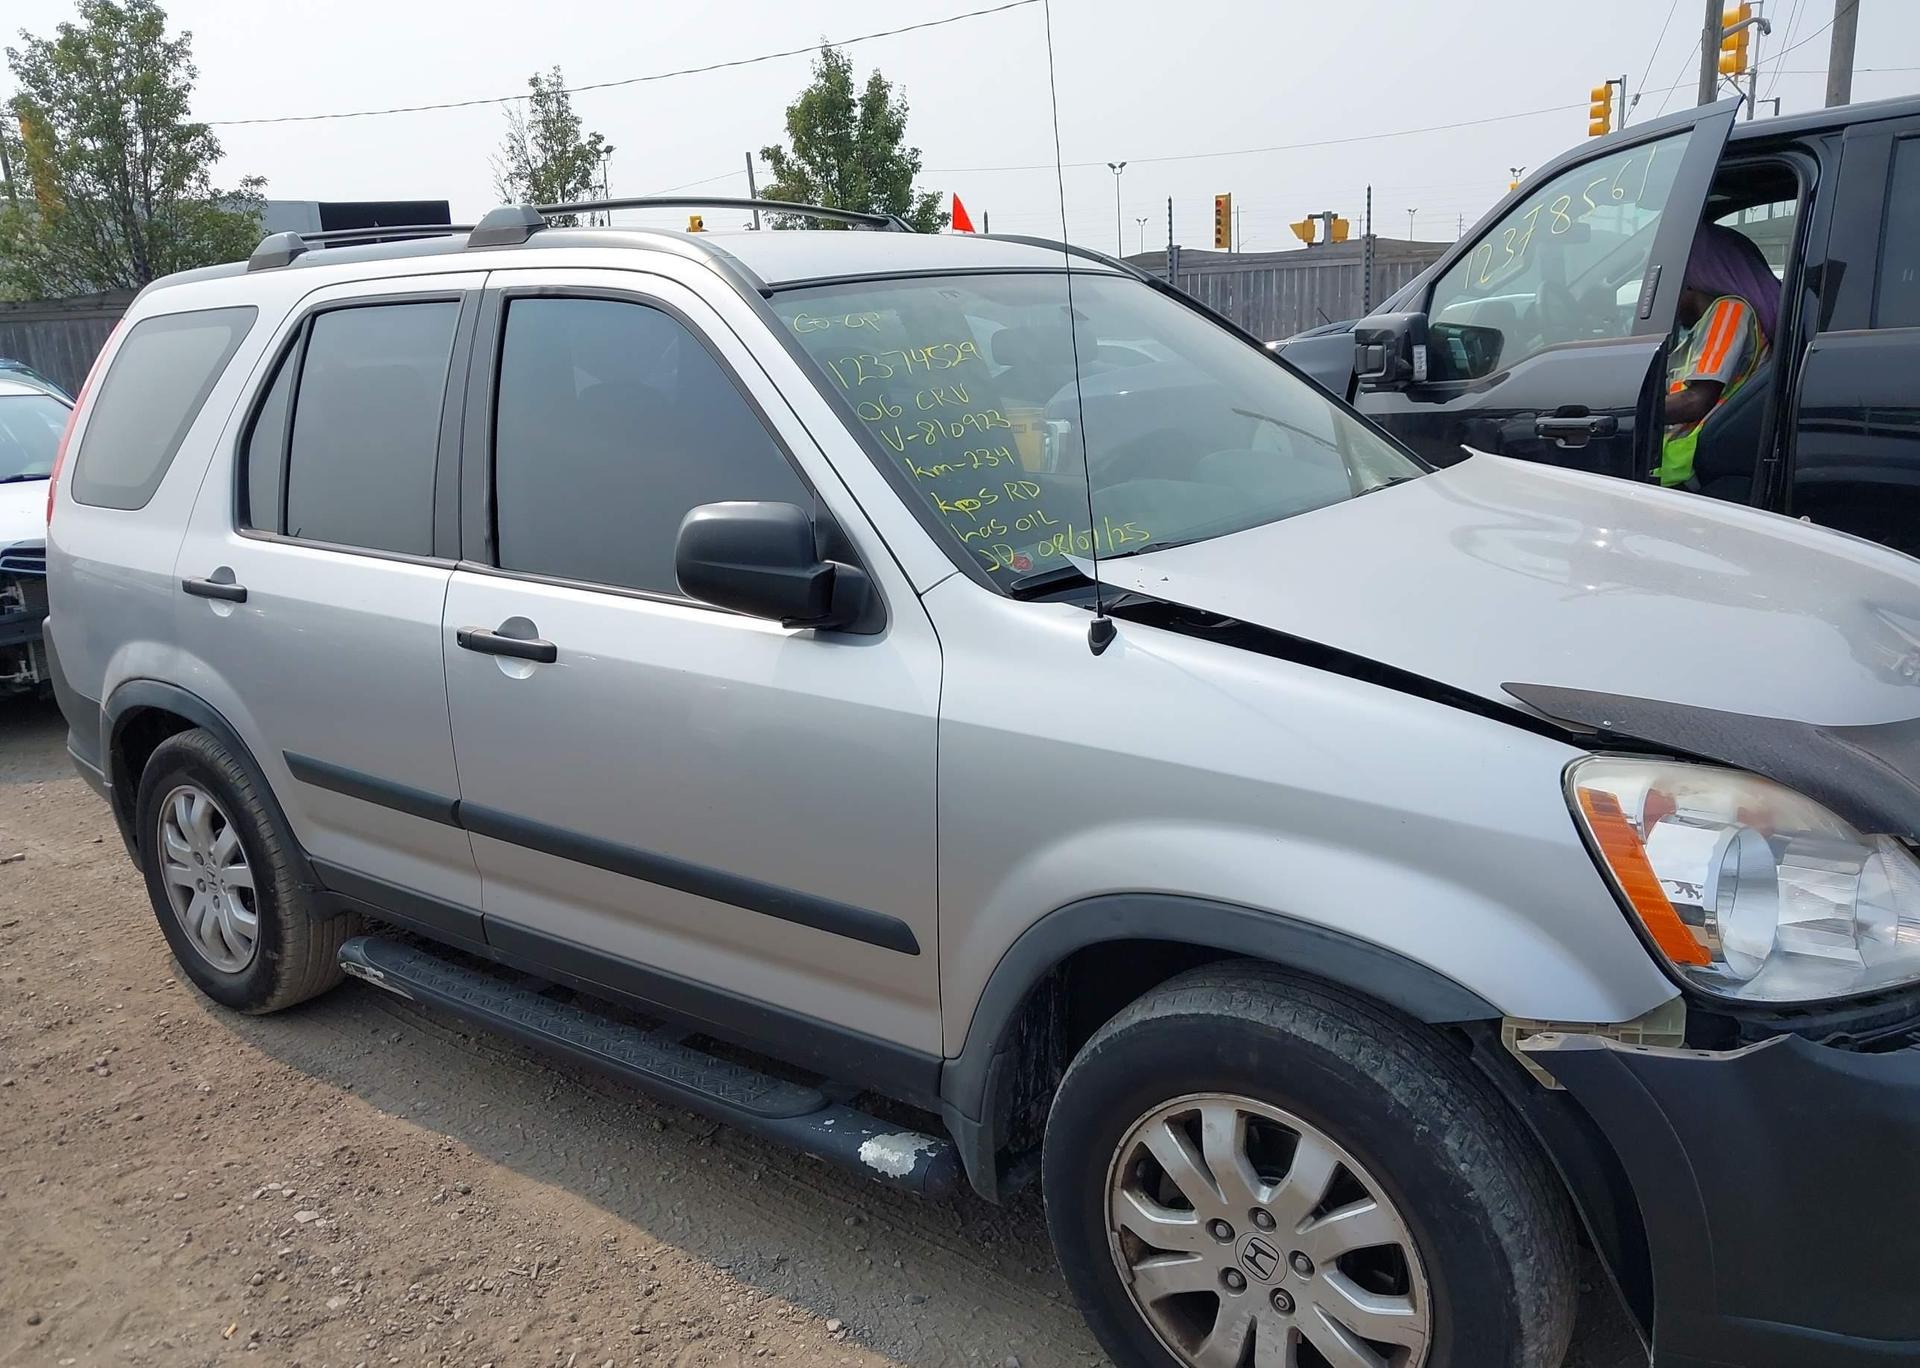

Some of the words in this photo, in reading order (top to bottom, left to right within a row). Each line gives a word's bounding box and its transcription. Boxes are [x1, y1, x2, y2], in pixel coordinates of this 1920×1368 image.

[1464, 145, 1657, 289] 12378561
[827, 341, 983, 390] 12374529
[856, 393, 903, 421] 06
[915, 382, 970, 411] CRV
[879, 408, 1012, 452] V-810923
[1003, 480, 1041, 502] RD
